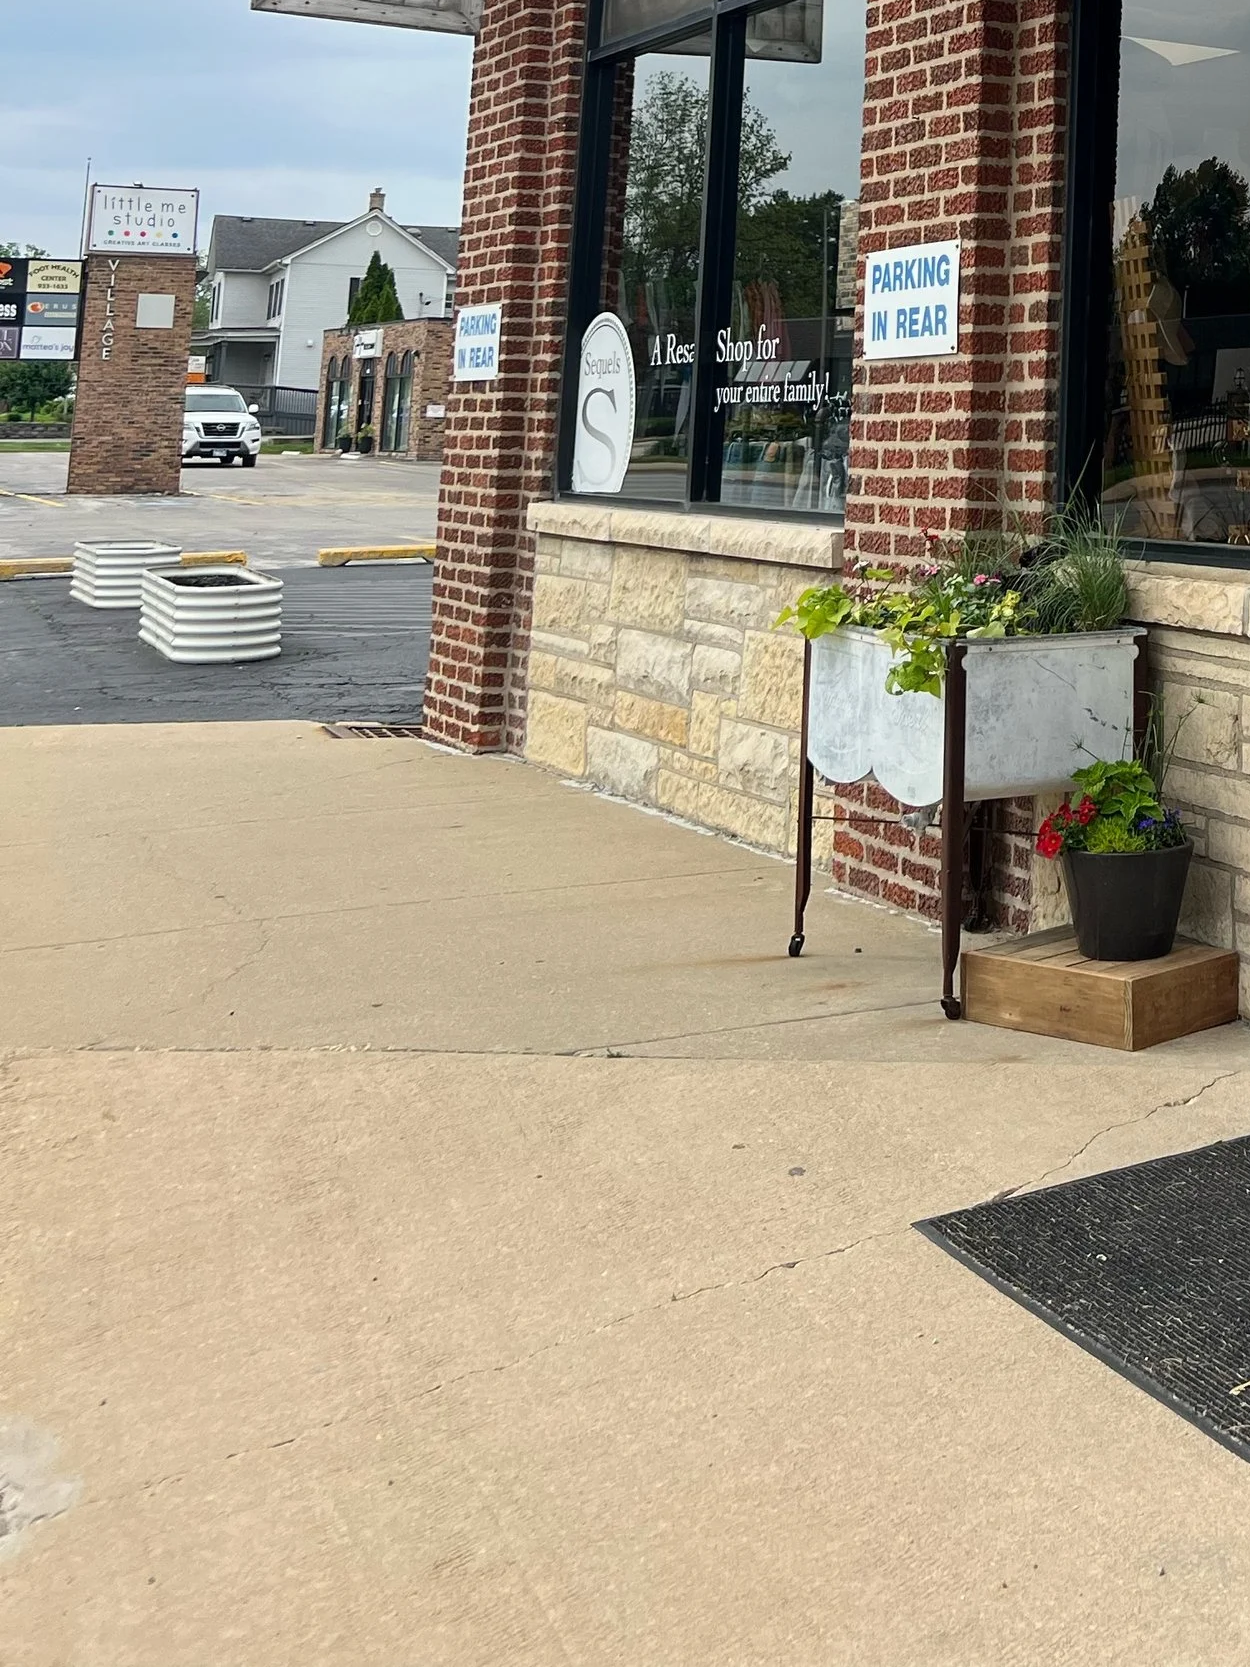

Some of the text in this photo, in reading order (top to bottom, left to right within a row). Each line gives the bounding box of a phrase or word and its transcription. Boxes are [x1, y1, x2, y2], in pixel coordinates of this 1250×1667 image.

[104, 194, 186, 214] little me
[113, 212, 175, 228] studio
[28, 264, 79, 279] FOOT HEALTH
[872, 254, 951, 294] PARKING
[0, 304, 17, 317] ess
[101, 259, 120, 361] VILLAGE
[872, 304, 947, 342] IN REAR
[459, 313, 497, 337] PARKING
[60, 344, 74, 353] joy
[457, 346, 495, 369] IN REAR
[650, 335, 663, 366] A
[715, 327, 754, 372] Shop
[755, 324, 780, 360] for
[584, 350, 621, 379] Sequels
[714, 370, 830, 413] your entire family!
[577, 387, 618, 486] S
